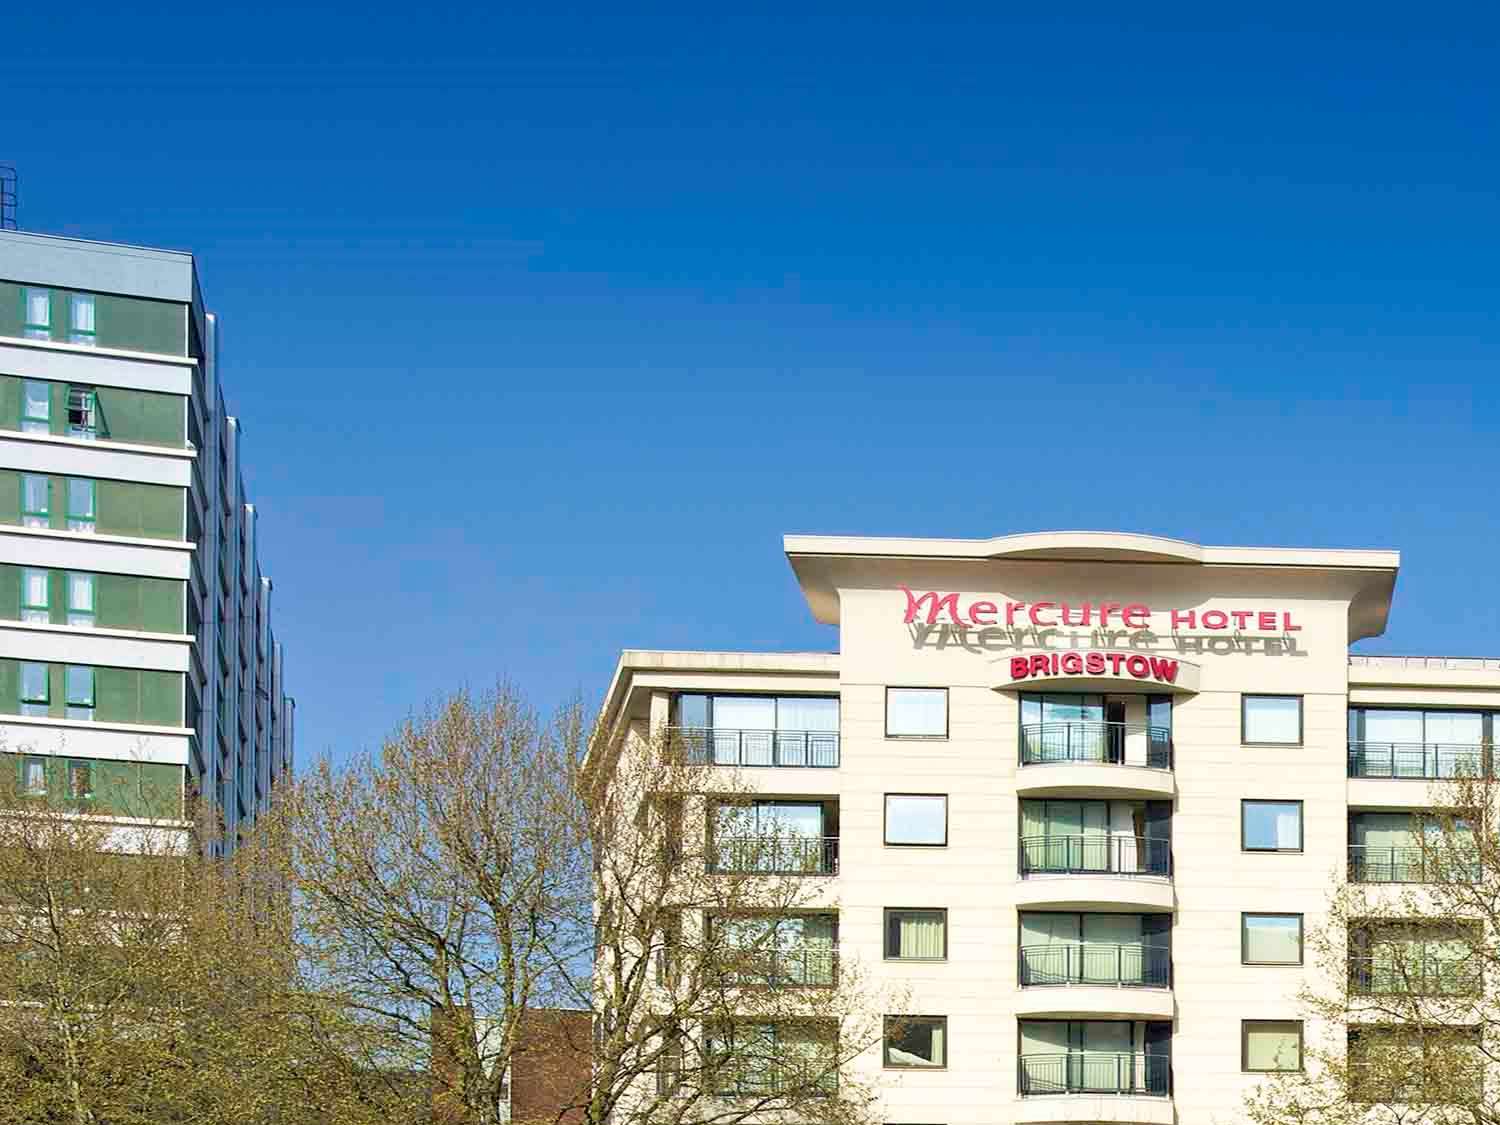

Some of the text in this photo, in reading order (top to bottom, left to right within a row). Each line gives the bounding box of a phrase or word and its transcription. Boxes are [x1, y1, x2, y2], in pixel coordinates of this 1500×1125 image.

[896, 584, 1302, 631] Mercure HOTEL
[1010, 652, 1179, 682] BRIGSTOW
